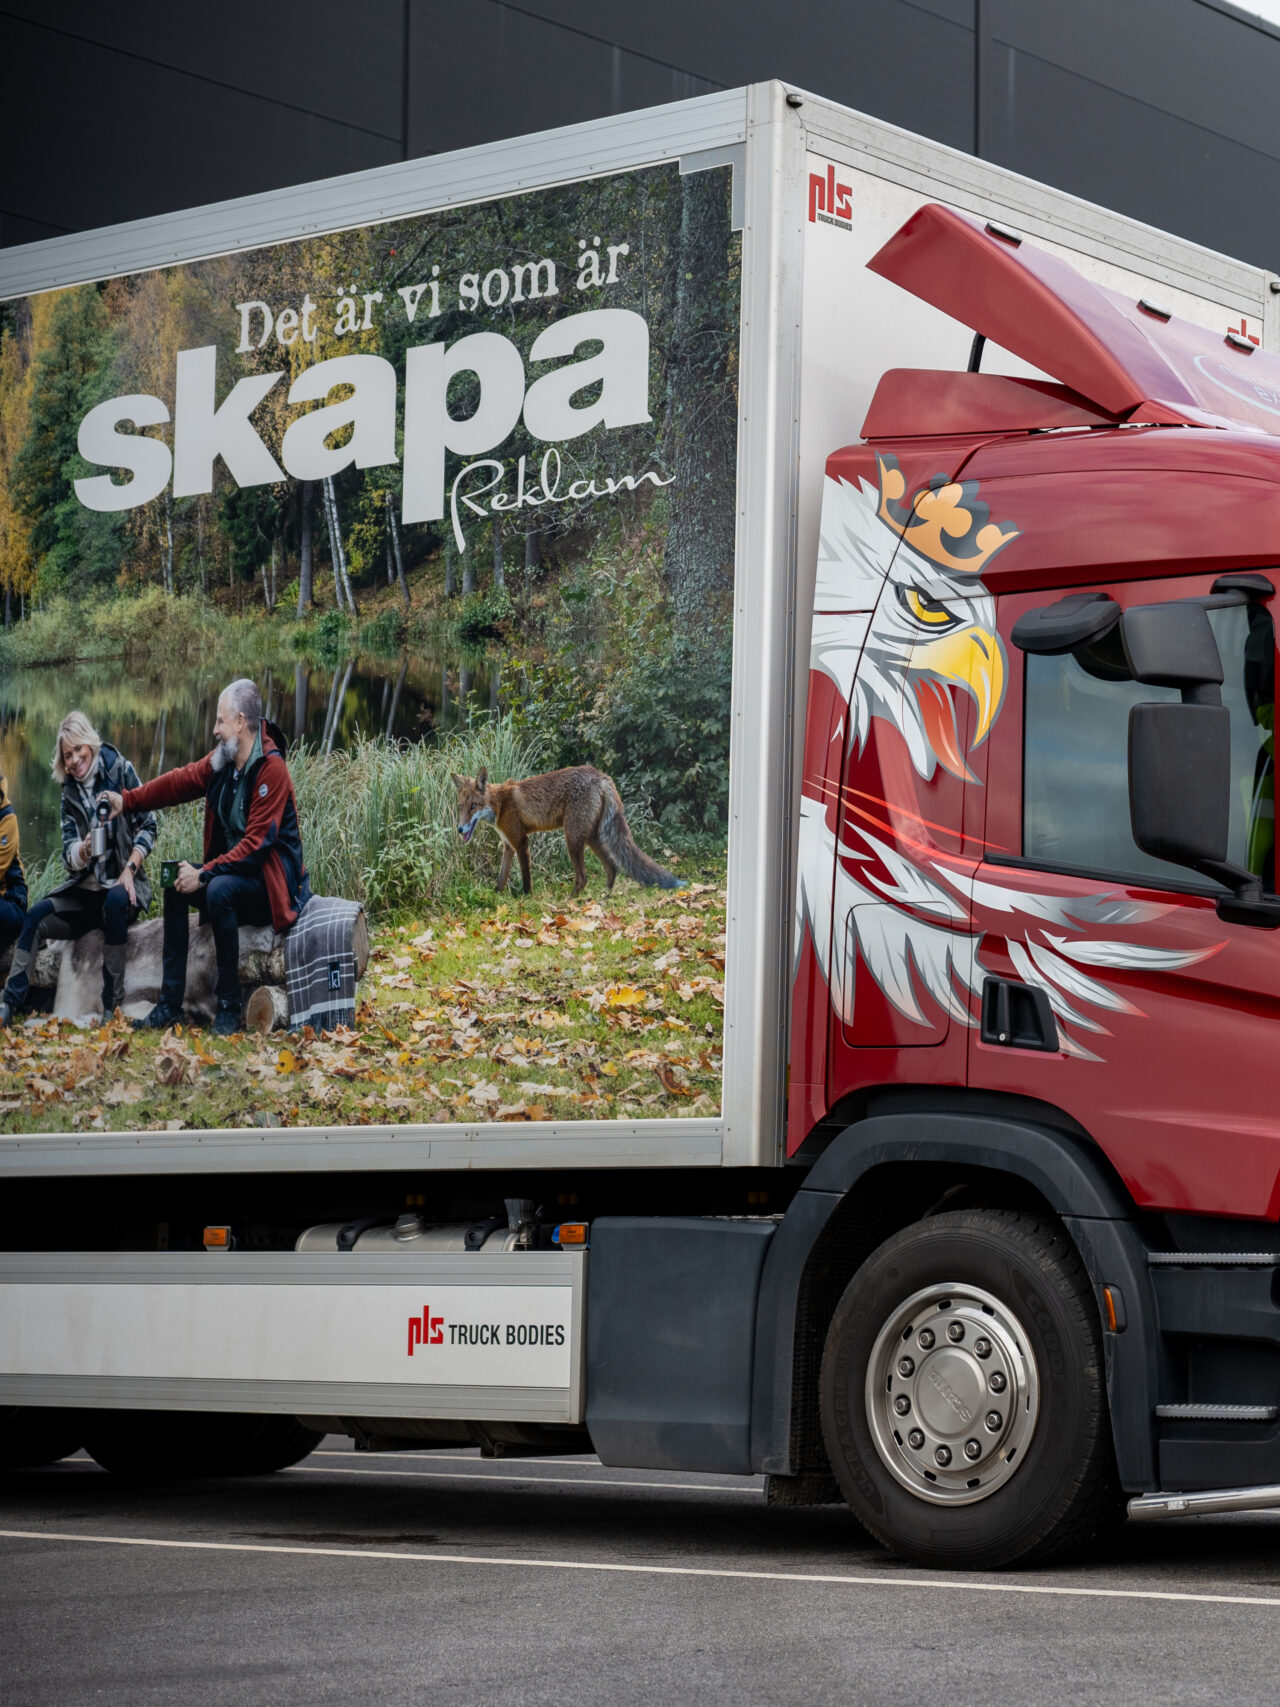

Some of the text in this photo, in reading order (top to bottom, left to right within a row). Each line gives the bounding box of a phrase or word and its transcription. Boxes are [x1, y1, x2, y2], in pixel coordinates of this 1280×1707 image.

[235, 235, 630, 353] Det är vi som är
[73, 308, 654, 525] skapa
[450, 447, 677, 555] Reklam
[407, 1304, 566, 1357] pls TRUCK BODIES
